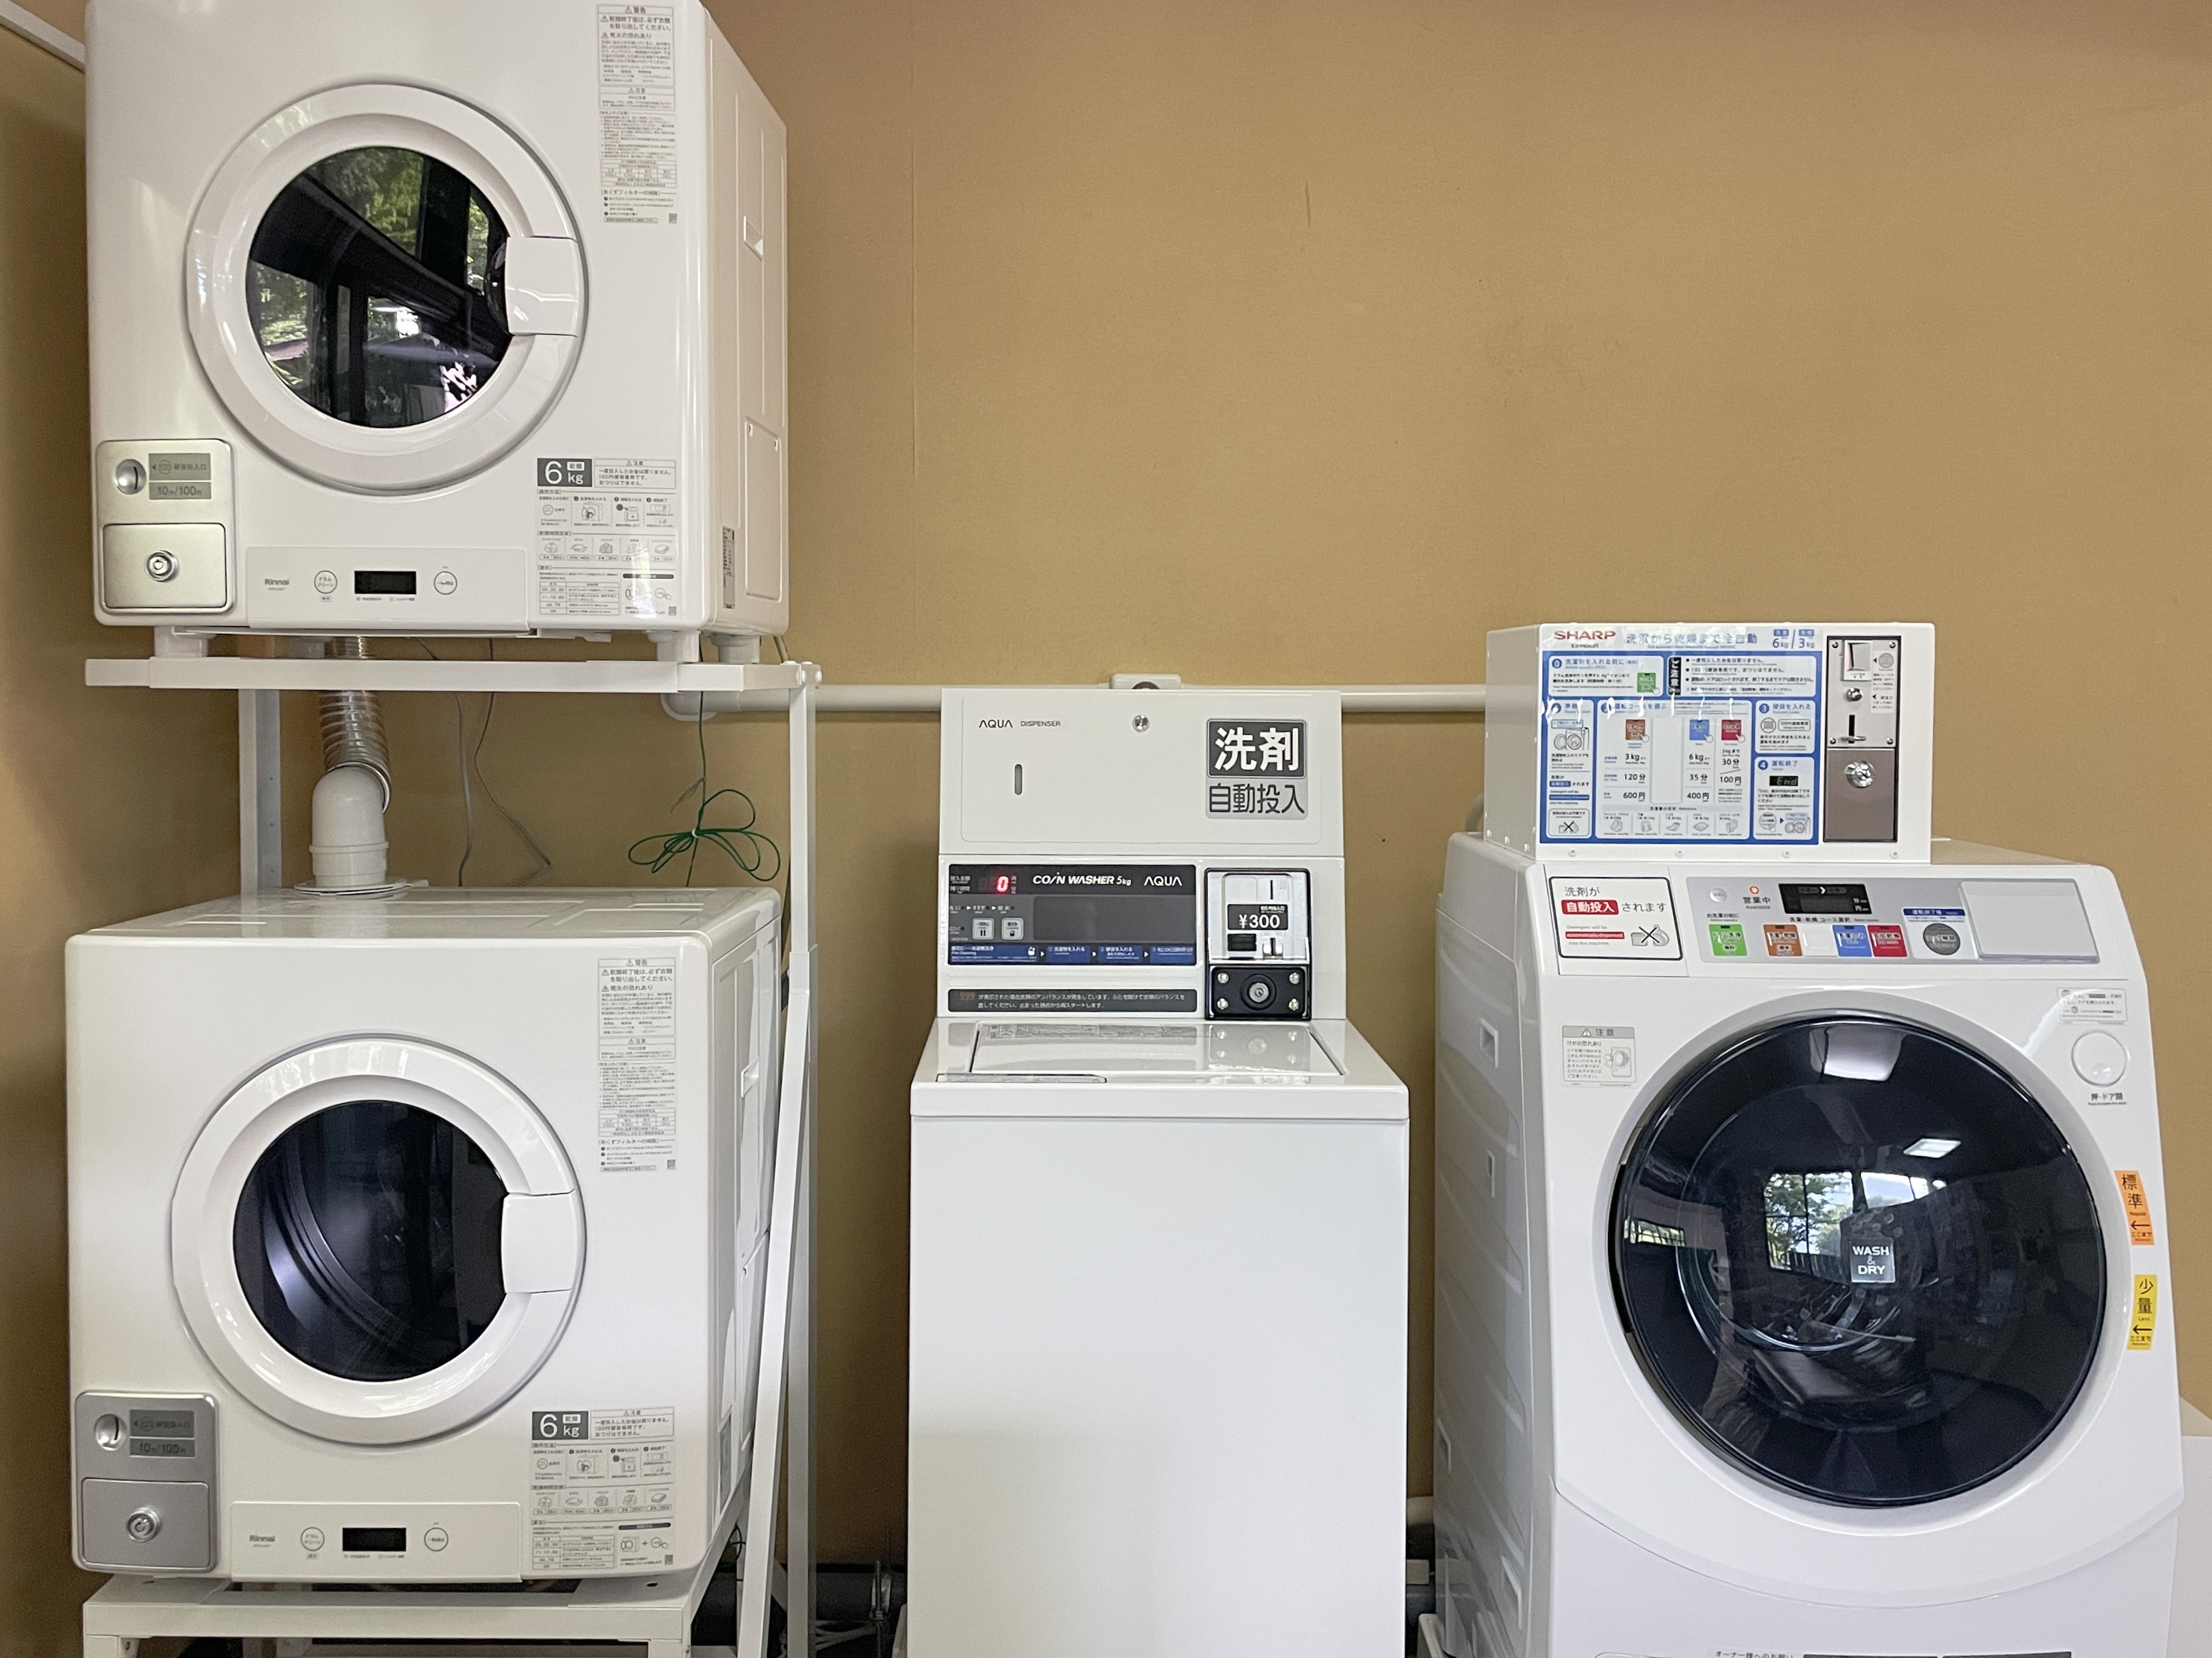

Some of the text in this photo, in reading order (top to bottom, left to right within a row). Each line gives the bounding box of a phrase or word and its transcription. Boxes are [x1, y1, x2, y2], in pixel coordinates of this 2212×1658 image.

[545, 460, 563, 485] 6
[568, 472, 583, 485] kg
[1554, 630, 1616, 640] SHARP
[979, 719, 1013, 729] AQUA
[1214, 727, 1300, 772] 洗剤
[1208, 783, 1305, 814] 自動投入
[996, 876, 1009, 892] 0
[1032, 871, 1132, 886] COIN WASHER 5kg
[1144, 876, 1182, 886] AQUA
[1564, 886, 1601, 897] 洗剤が
[1566, 901, 1666, 913] 自動投入 されます
[1239, 914, 1280, 929] ¥300
[1595, 1028, 1615, 1037] 注意
[2121, 1173, 2142, 1209] 標準
[1852, 1246, 1889, 1256] WASH
[1867, 1255, 1876, 1265] &
[1858, 1265, 1886, 1275] DRY
[2138, 1278, 2154, 1314] 少量
[539, 1414, 558, 1438] 6
[563, 1425, 580, 1437] kg
